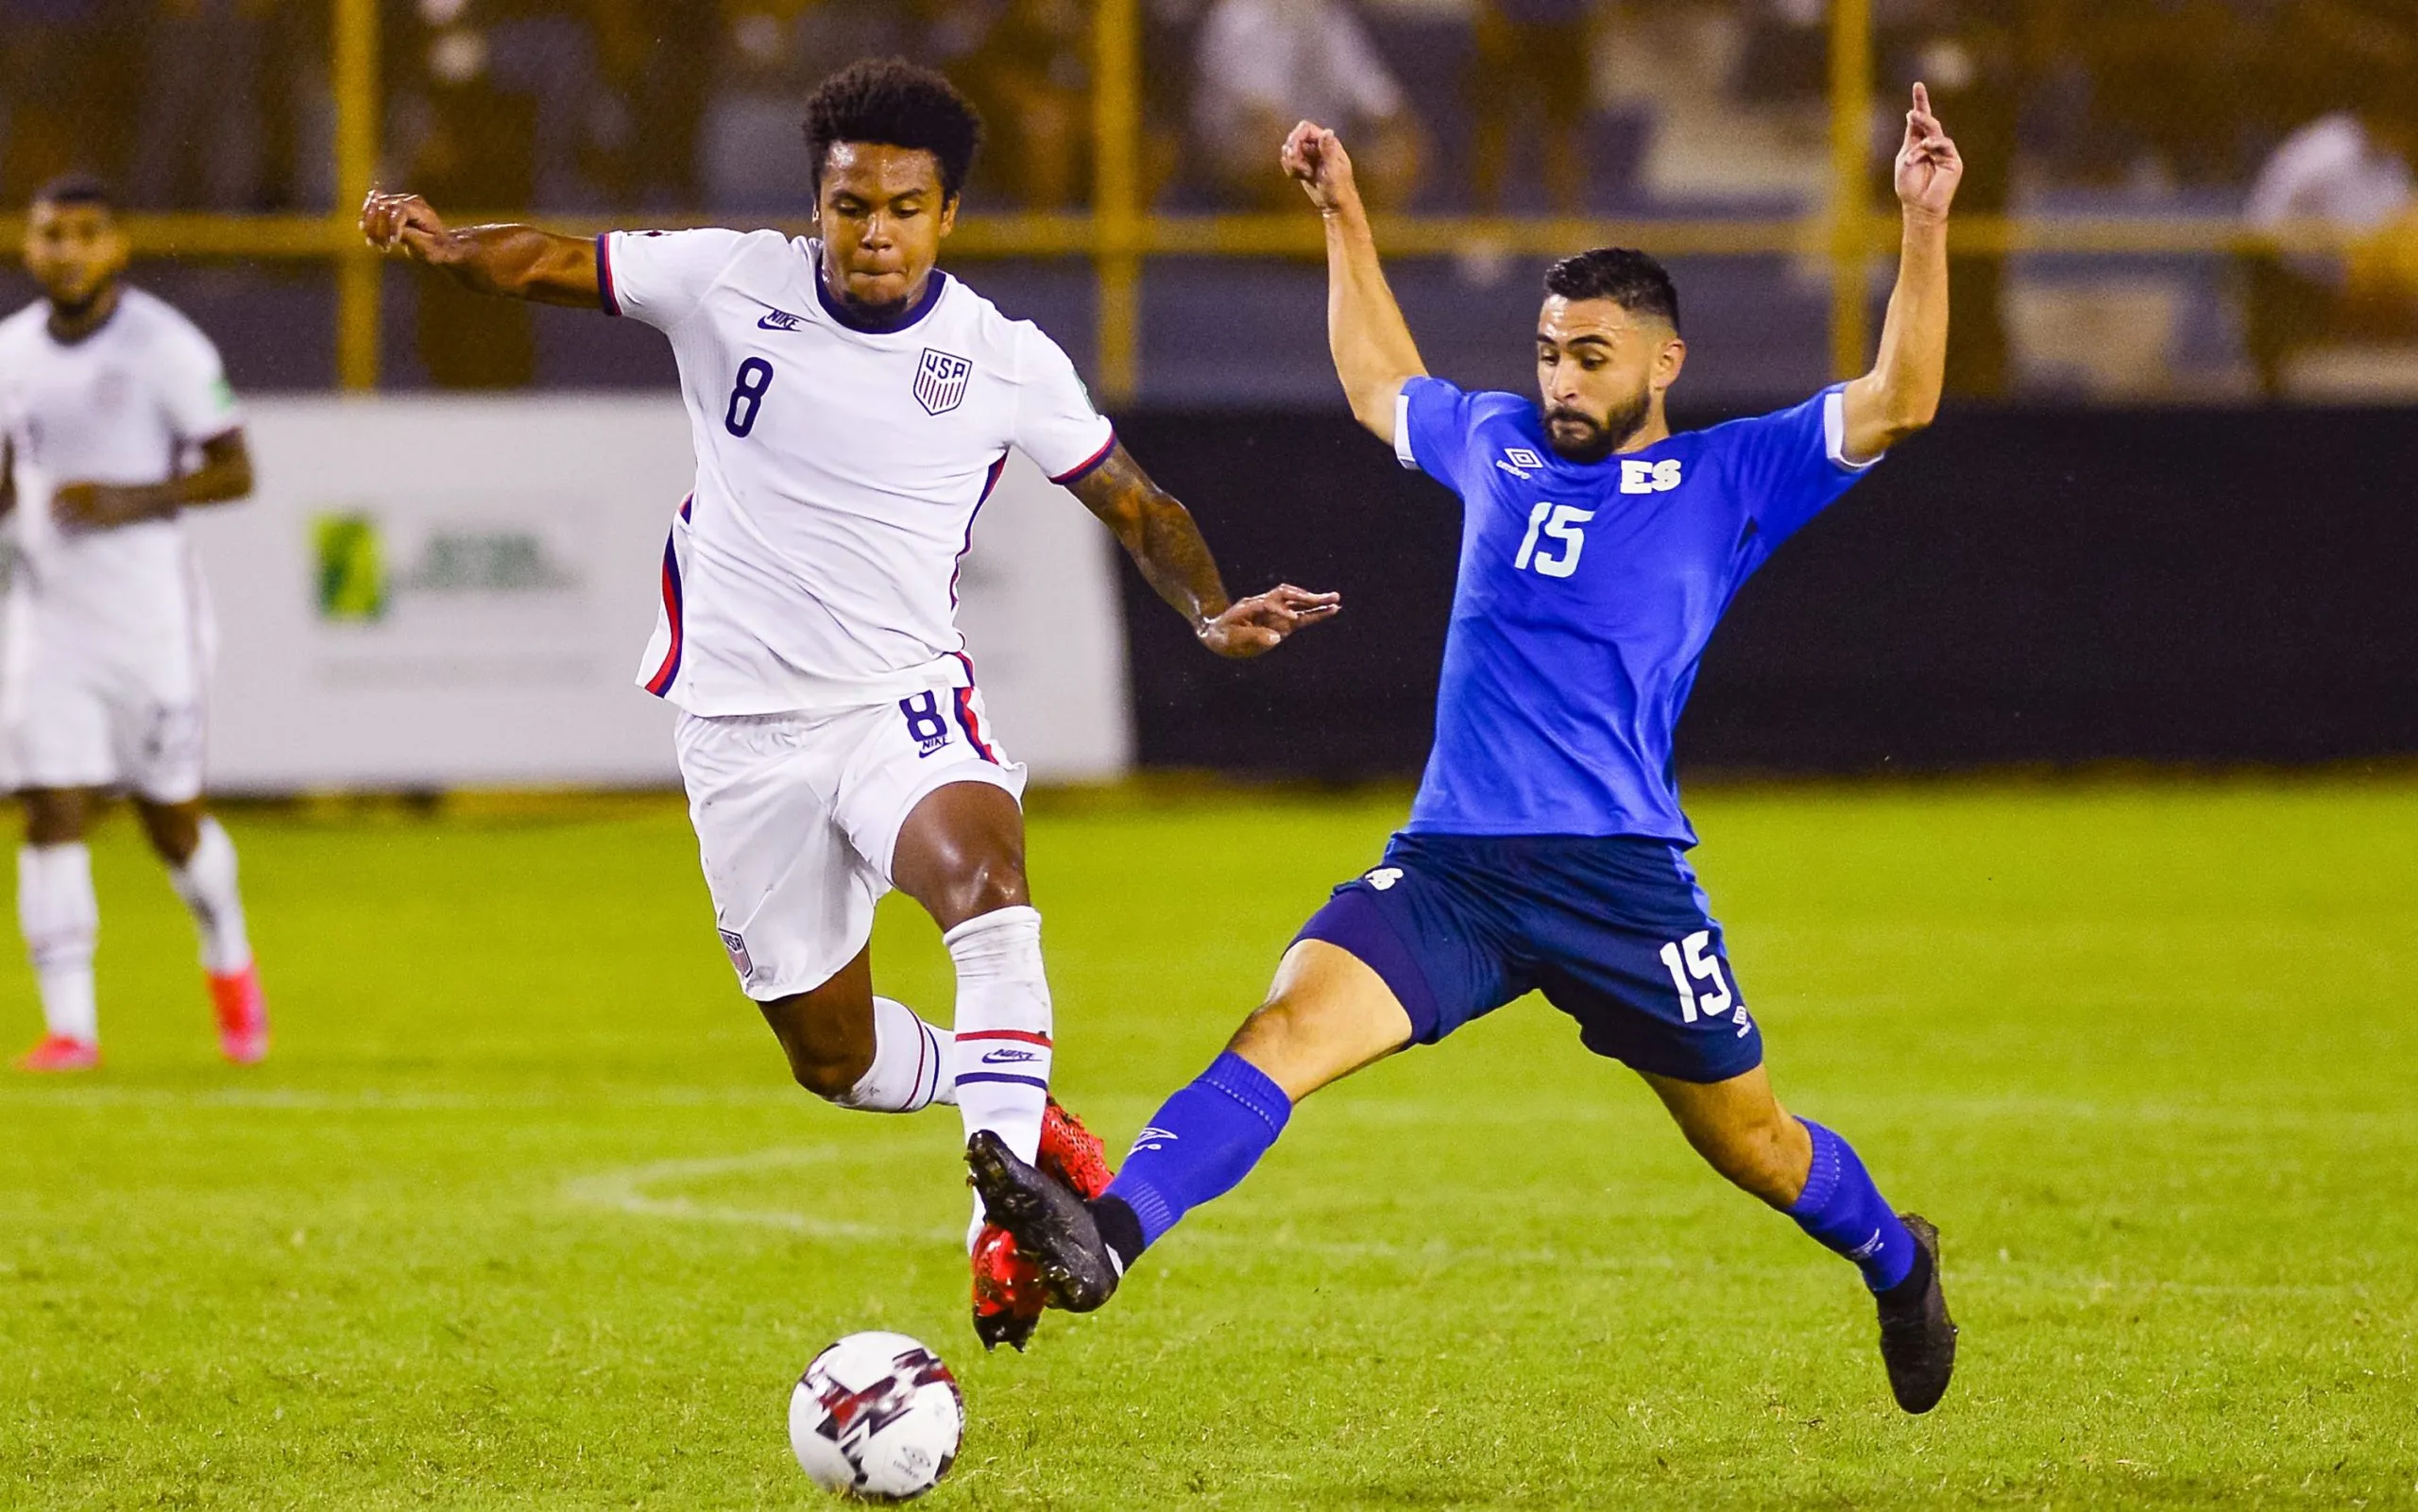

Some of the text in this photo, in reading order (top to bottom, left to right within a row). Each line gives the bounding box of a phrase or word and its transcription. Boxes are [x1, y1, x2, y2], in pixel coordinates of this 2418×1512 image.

[767, 309, 799, 330] NIKE
[926, 353, 966, 380] USA
[724, 356, 774, 438] 8
[1619, 458, 1682, 494] ES
[1514, 501, 1596, 578] 15
[899, 689, 947, 742] 8
[1659, 930, 1732, 1023] 15
